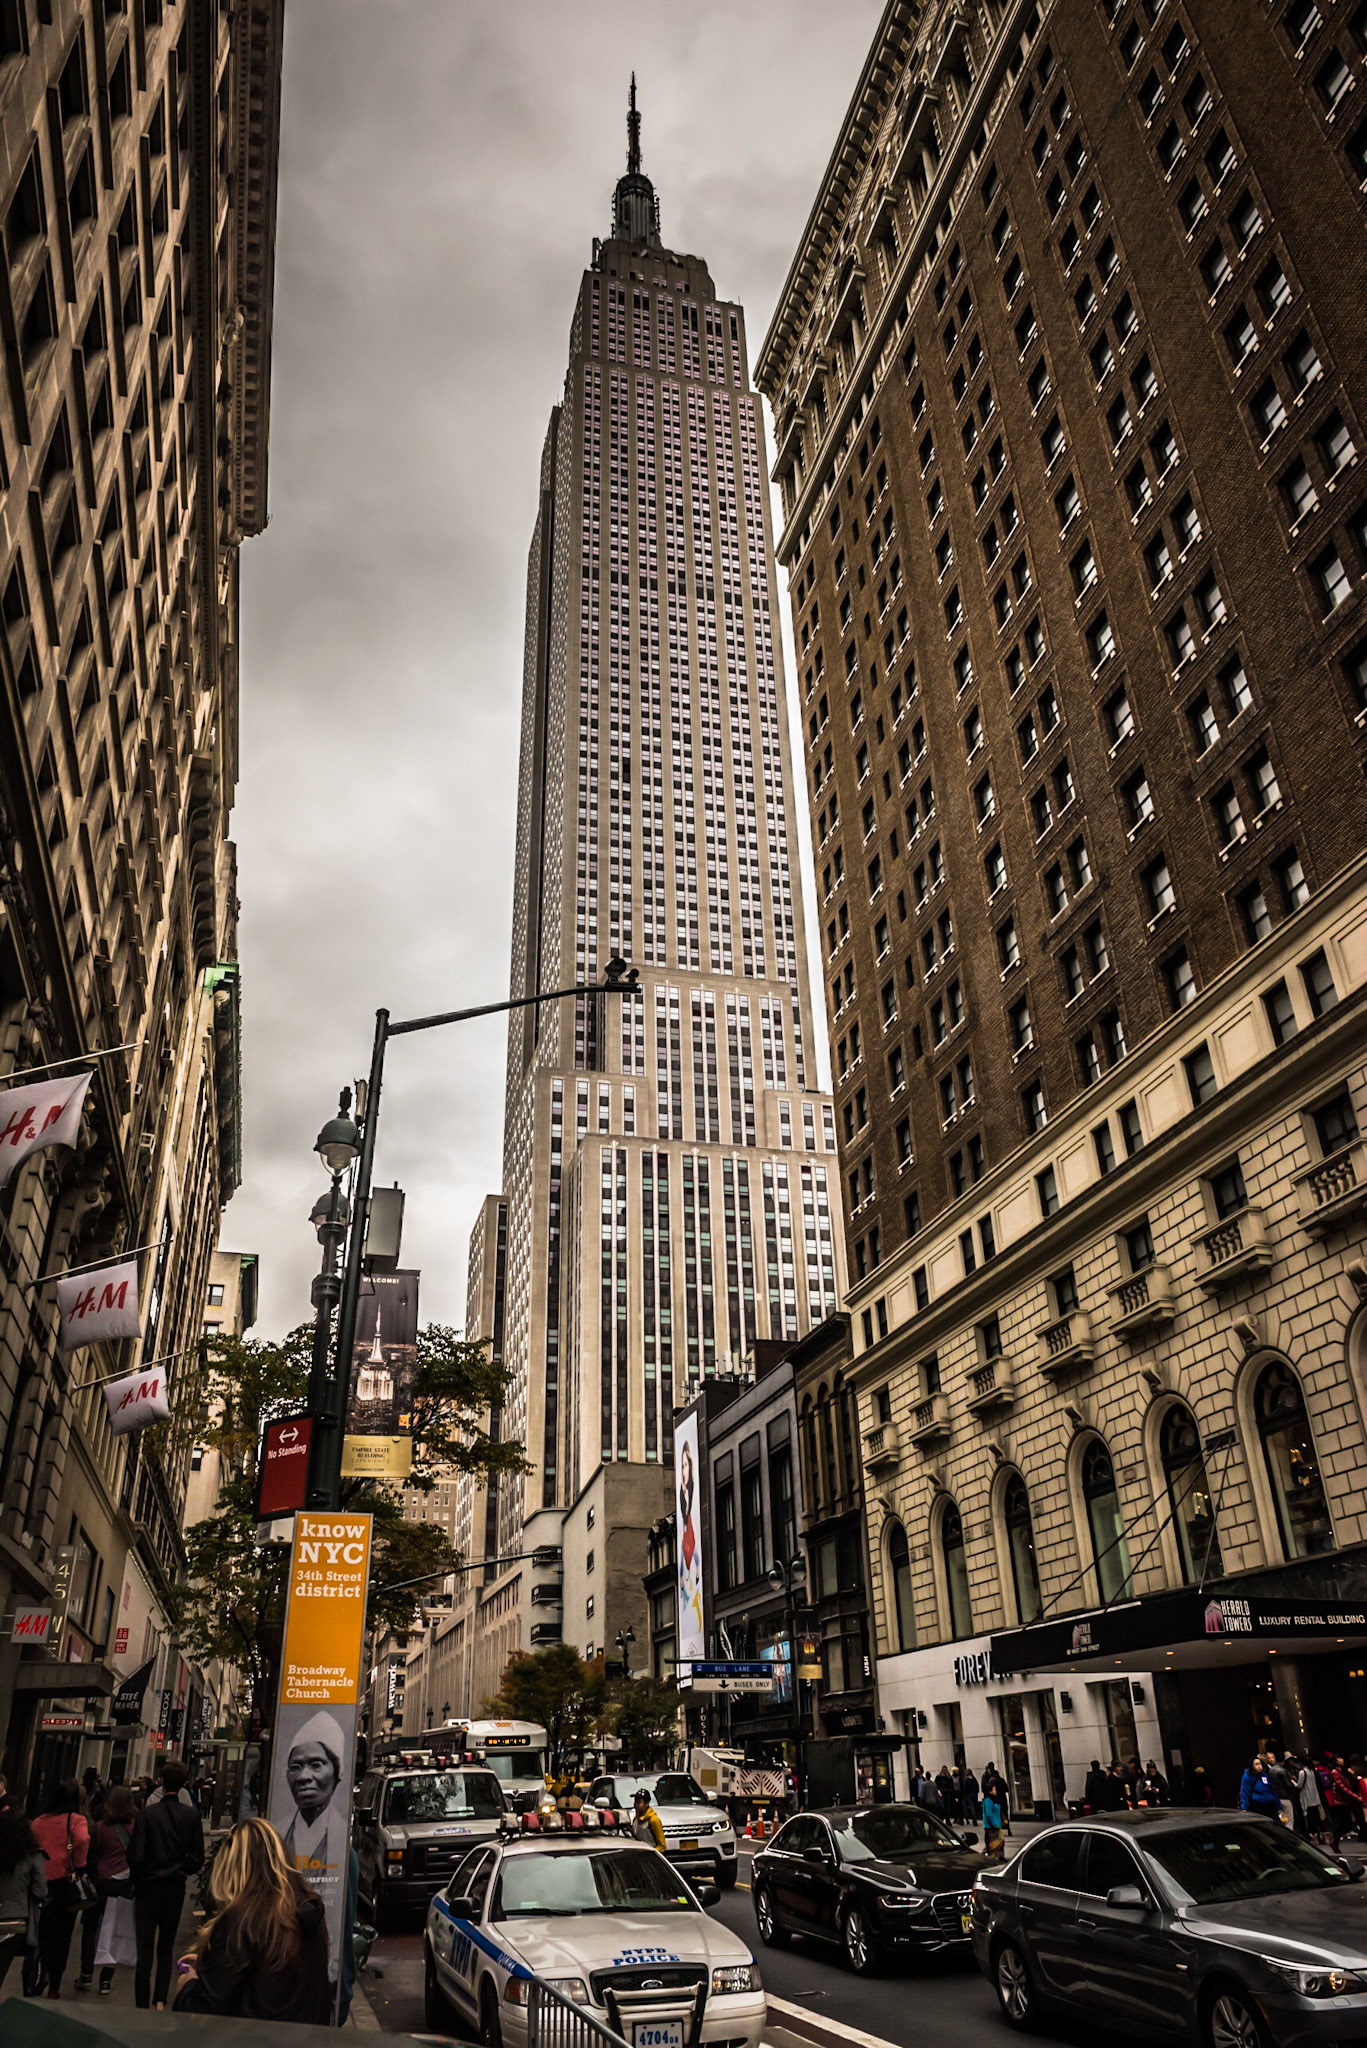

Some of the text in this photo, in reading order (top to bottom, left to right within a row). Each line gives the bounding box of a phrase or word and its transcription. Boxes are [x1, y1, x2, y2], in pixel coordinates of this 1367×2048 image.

[69, 1281, 128, 1323] H&M
[115, 1379, 159, 1414] H&M
[268, 1443, 307, 1459] No Standing
[301, 1518, 365, 1538] know
[298, 1541, 363, 1564] NYC
[297, 1570, 361, 1582] 34th Street
[295, 1582, 360, 1598] district
[1221, 1600, 1250, 1616] HERALD
[14, 1614, 49, 1636] H&M
[1223, 1616, 1252, 1631] TOWERS
[1259, 1614, 1366, 1626] LUXURY RENTAL BUILDING
[288, 1664, 347, 1678] Broadway
[287, 1676, 354, 1687] Tabernacle
[387, 1664, 397, 1709] wework
[286, 1688, 331, 1698] Church
[160, 1692, 171, 1728] GEOX
[175, 1711, 184, 1739] ALDO
[449, 1929, 472, 1977] NYPD
[612, 1954, 680, 1966] POLICE
[621, 1948, 667, 1956] NYPD
[496, 1951, 518, 1973] POLICE
